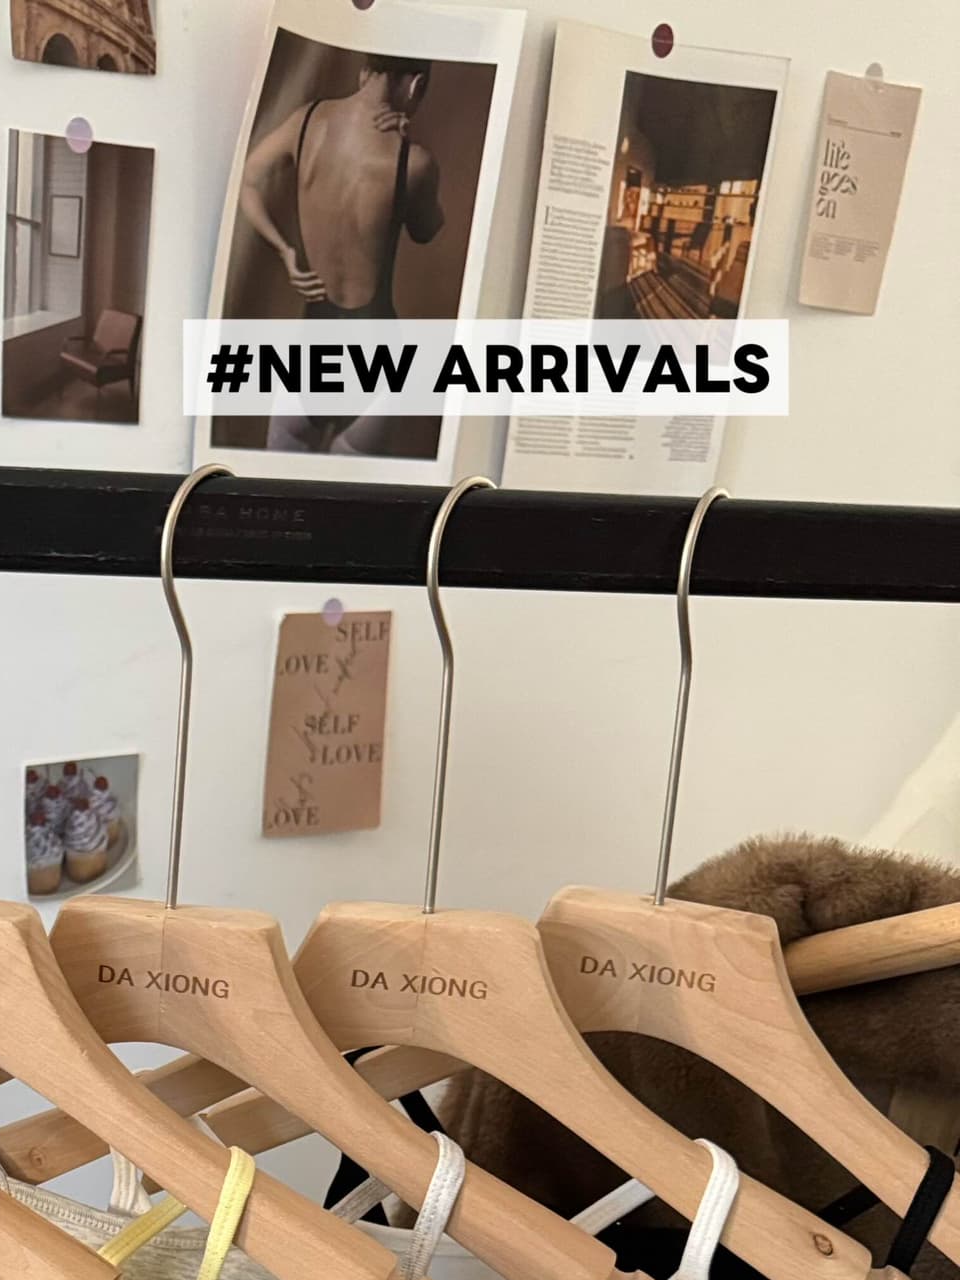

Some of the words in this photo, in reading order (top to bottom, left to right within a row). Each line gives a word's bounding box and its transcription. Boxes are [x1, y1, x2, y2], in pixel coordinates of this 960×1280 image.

[279, 653, 329, 675] OVE
[268, 807, 319, 830] OVE
[98, 964, 134, 987] DA
[145, 970, 230, 999] XIONG
[350, 969, 388, 991] DA
[399, 974, 488, 1000] XIONG
[580, 955, 617, 978] DA
[627, 963, 716, 993] XIONG
